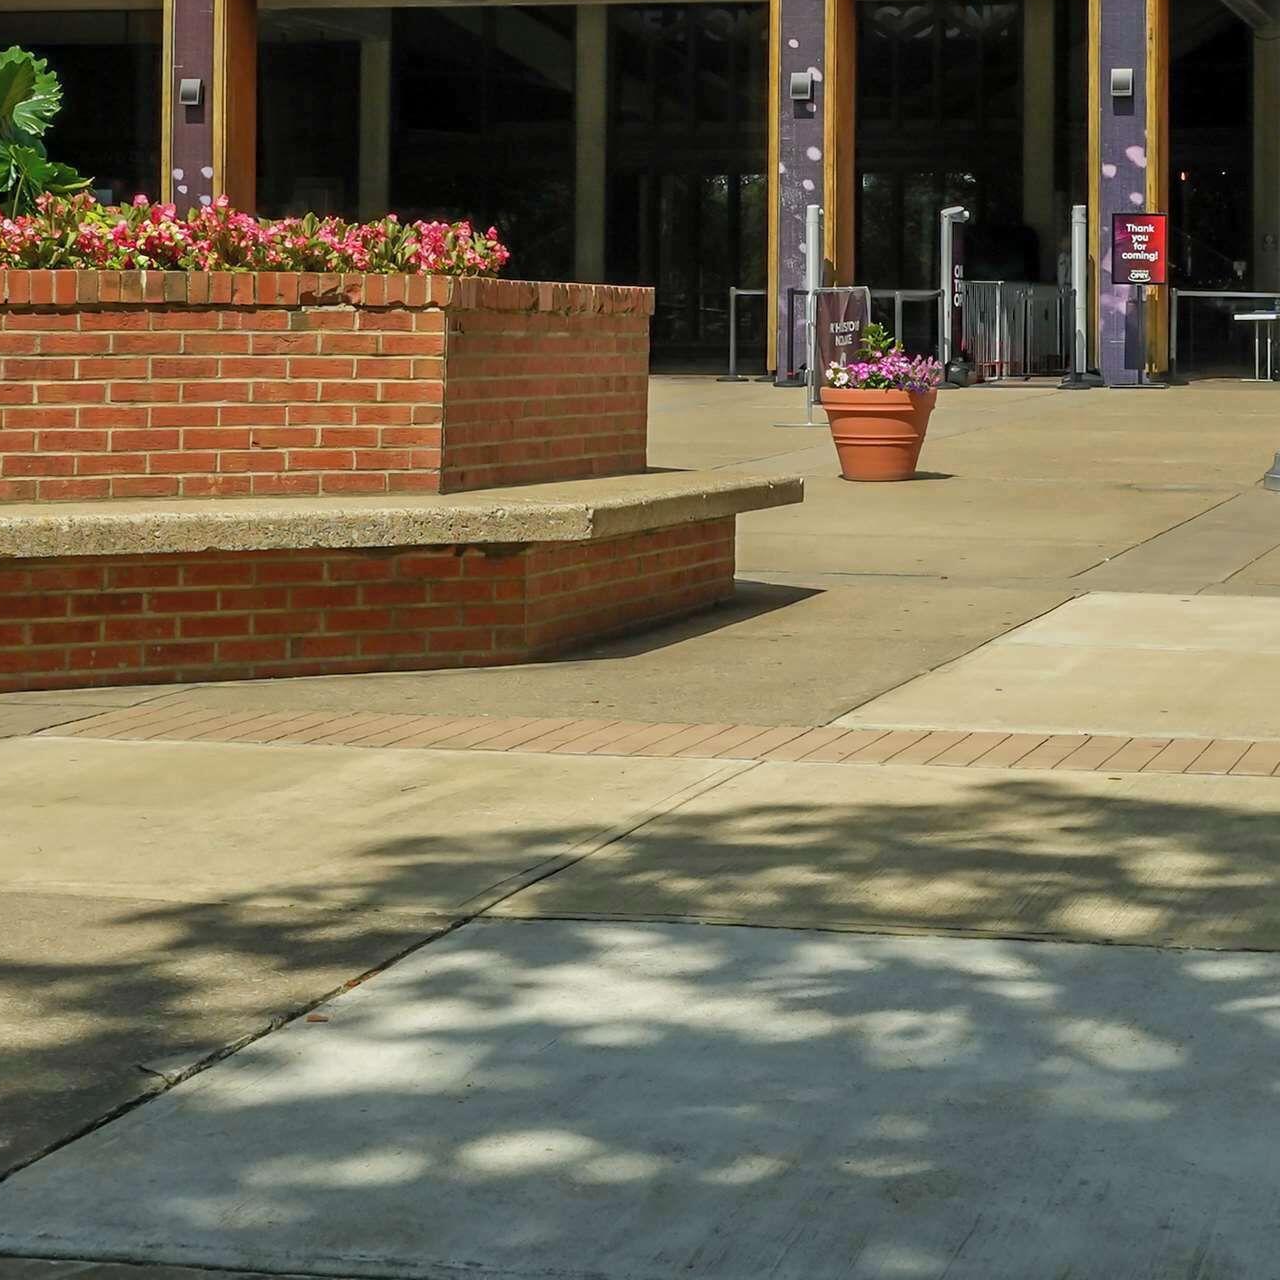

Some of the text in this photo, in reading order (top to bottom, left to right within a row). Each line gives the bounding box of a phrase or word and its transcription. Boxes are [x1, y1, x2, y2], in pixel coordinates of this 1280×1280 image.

[1126, 224, 1155, 232] Thank
[1132, 235, 1149, 243] you
[1121, 251, 1158, 262] coming!
